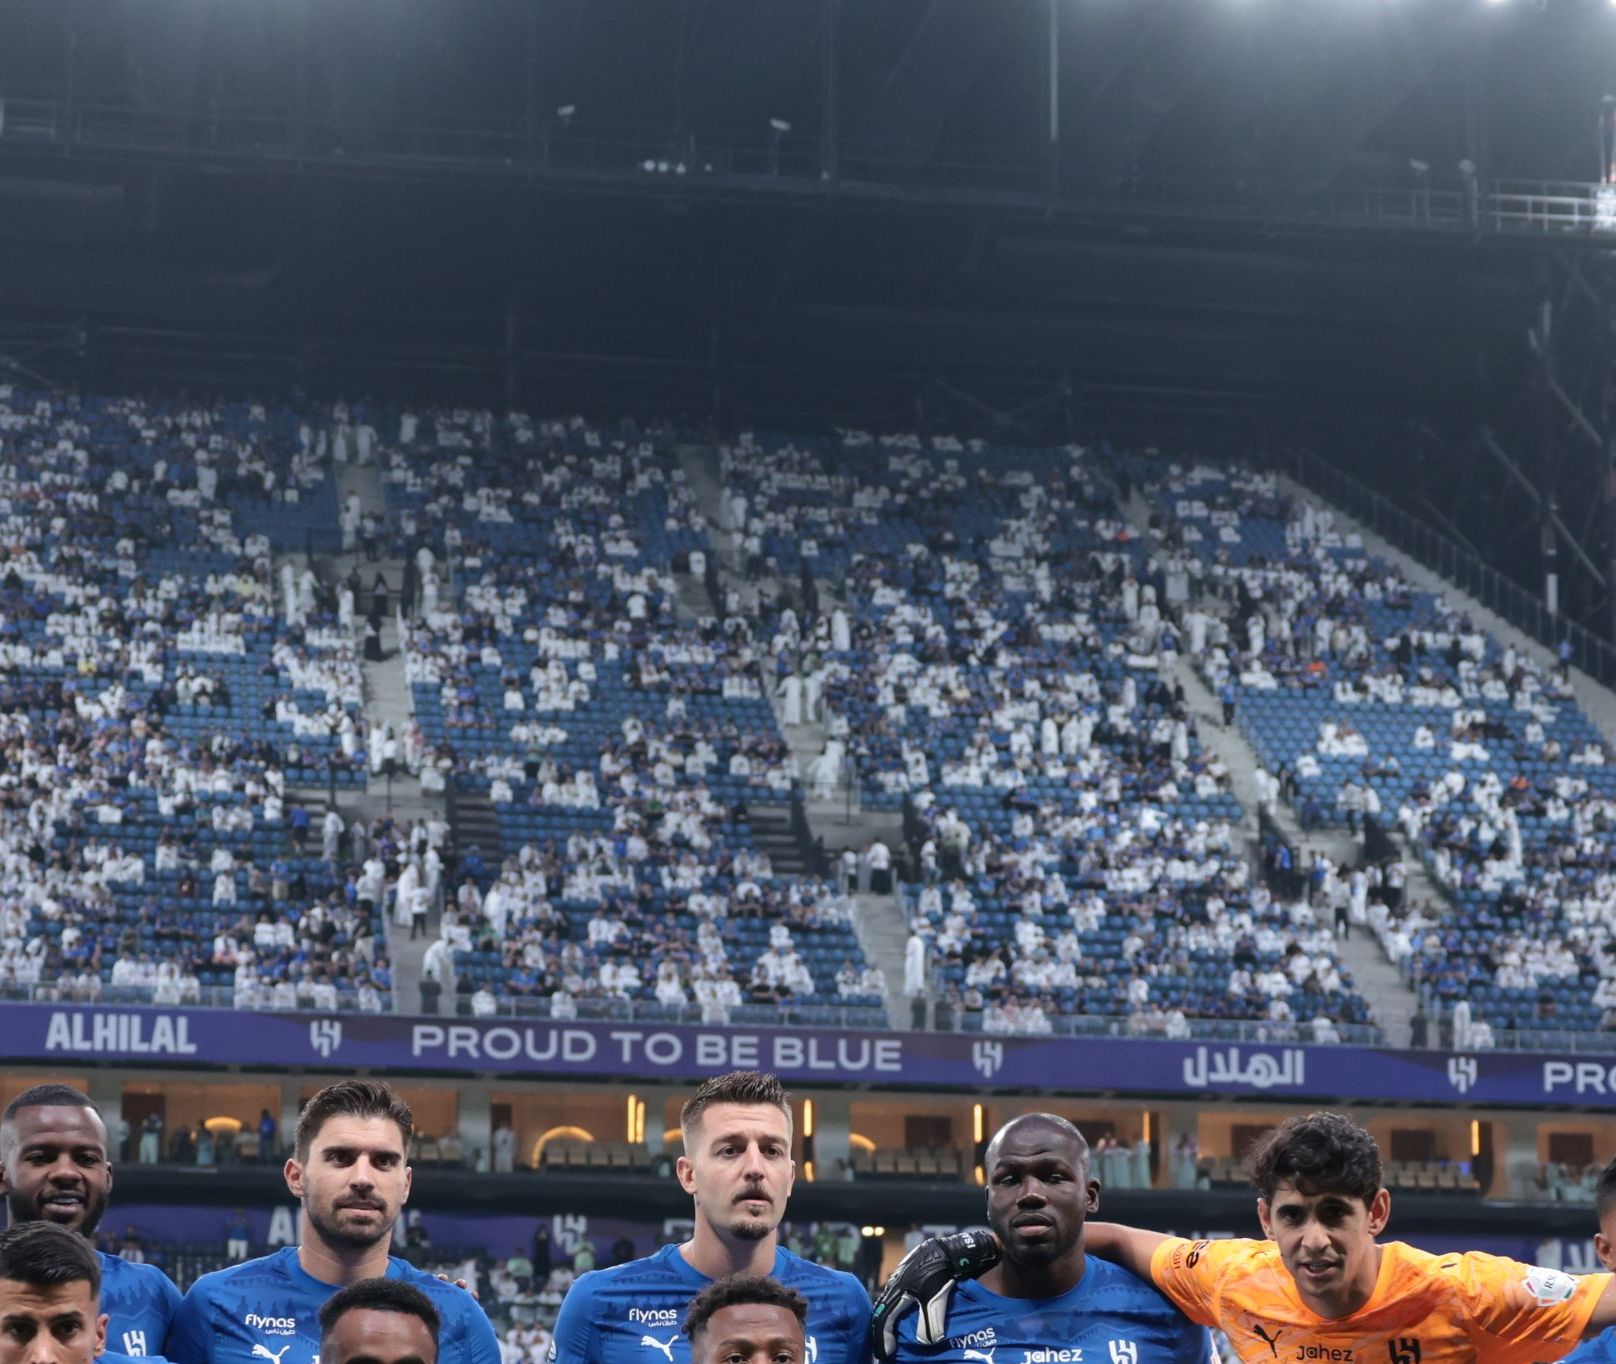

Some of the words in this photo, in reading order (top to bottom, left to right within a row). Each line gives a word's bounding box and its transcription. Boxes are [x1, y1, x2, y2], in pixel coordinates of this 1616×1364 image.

[45, 1012, 196, 1054] ALHILAL
[412, 1024, 597, 1062] PROUD
[611, 1031, 683, 1065] TO
[696, 1034, 760, 1068] BE
[773, 1037, 903, 1072] BLUE
[1185, 1046, 1305, 1088] الهلال
[245, 1313, 295, 1328] flynas
[629, 1308, 677, 1323] flynas
[949, 1327, 995, 1348] flynas
